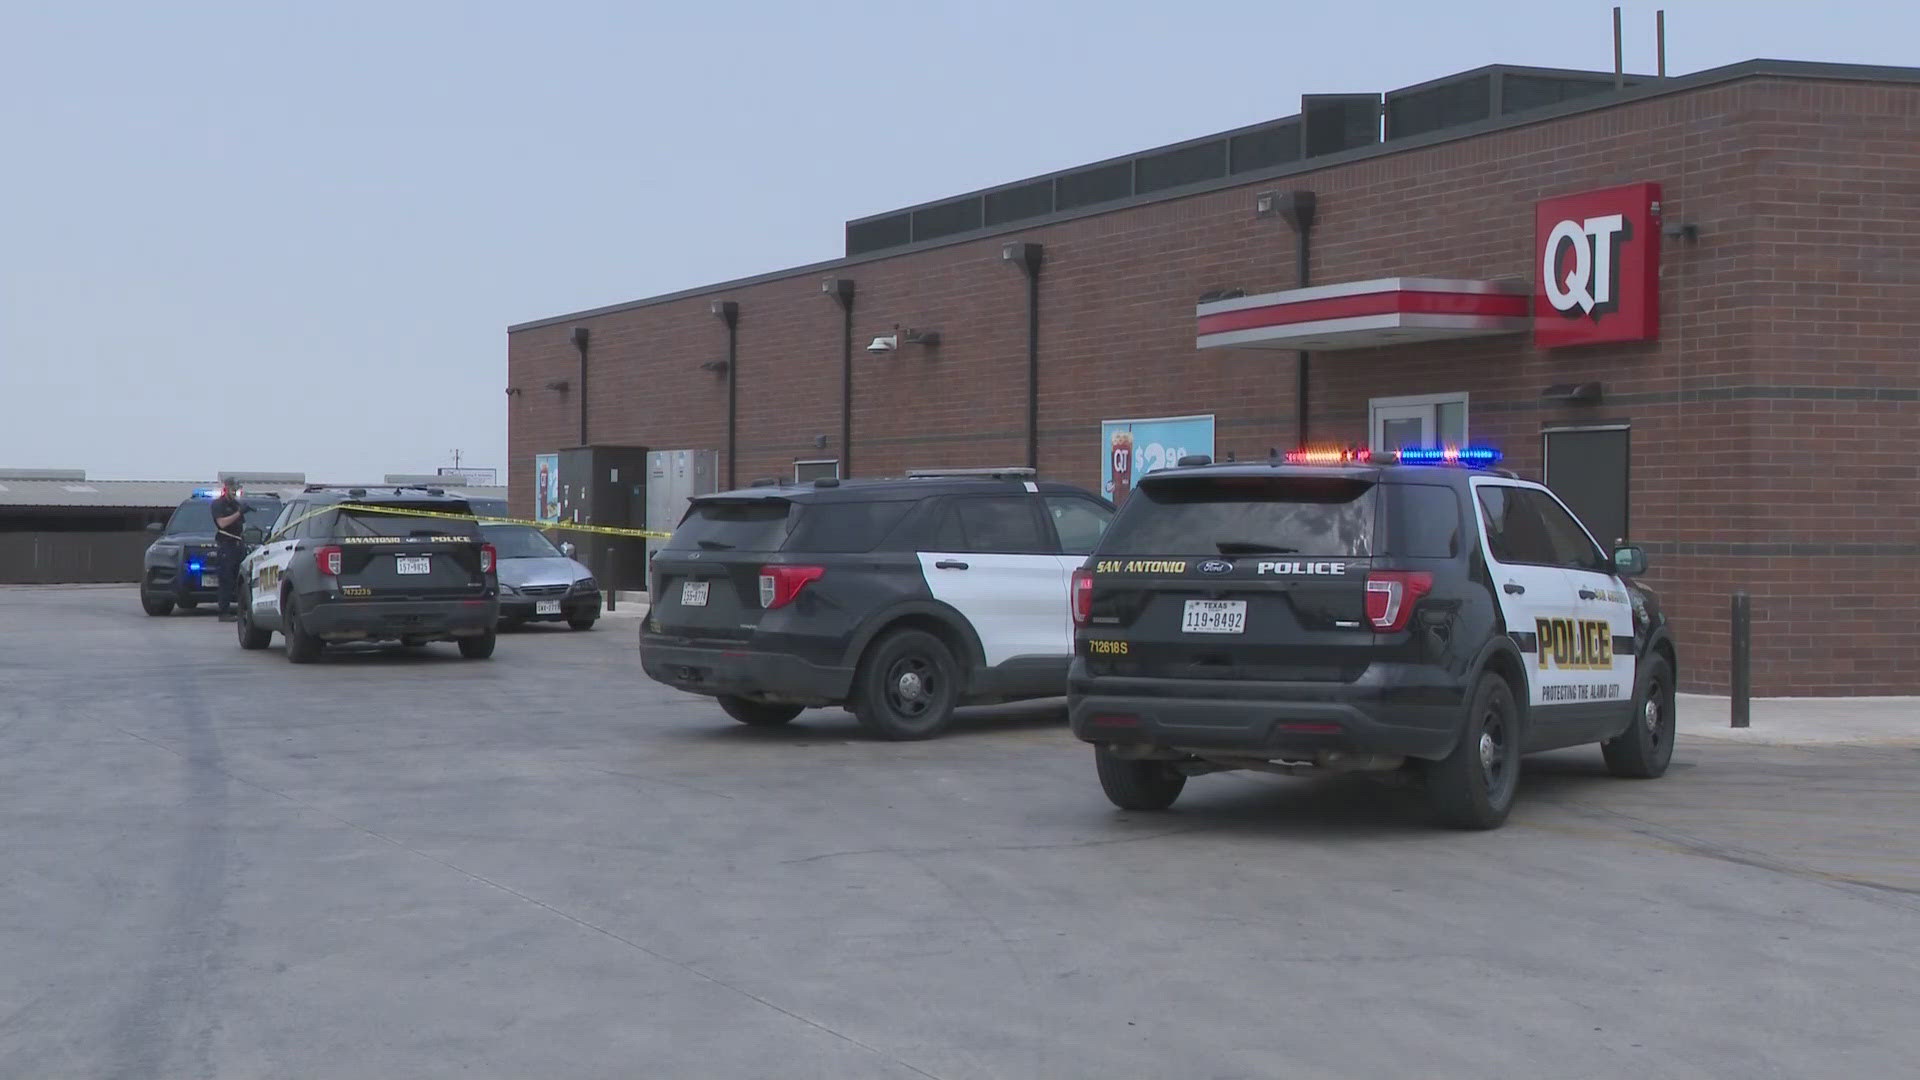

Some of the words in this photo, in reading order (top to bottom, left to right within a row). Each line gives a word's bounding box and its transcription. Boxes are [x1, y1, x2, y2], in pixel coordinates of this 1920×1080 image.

[1543, 213, 1625, 318] QT
[1113, 448, 1129, 474] QT
[362, 536, 400, 544] ANTONIO
[1097, 561, 1122, 573] SAN
[1125, 561, 1186, 574] ANTONIO
[1201, 561, 1228, 573] Ford
[1257, 562, 1345, 575] POLICE
[1204, 602, 1228, 610] TEXAS
[1534, 616, 1613, 671] POLICE
[1542, 685, 1577, 701] PROTECTING
[1577, 684, 1589, 699] THE
[1590, 684, 1608, 699] ALAMO
[1608, 683, 1620, 698] CITY
